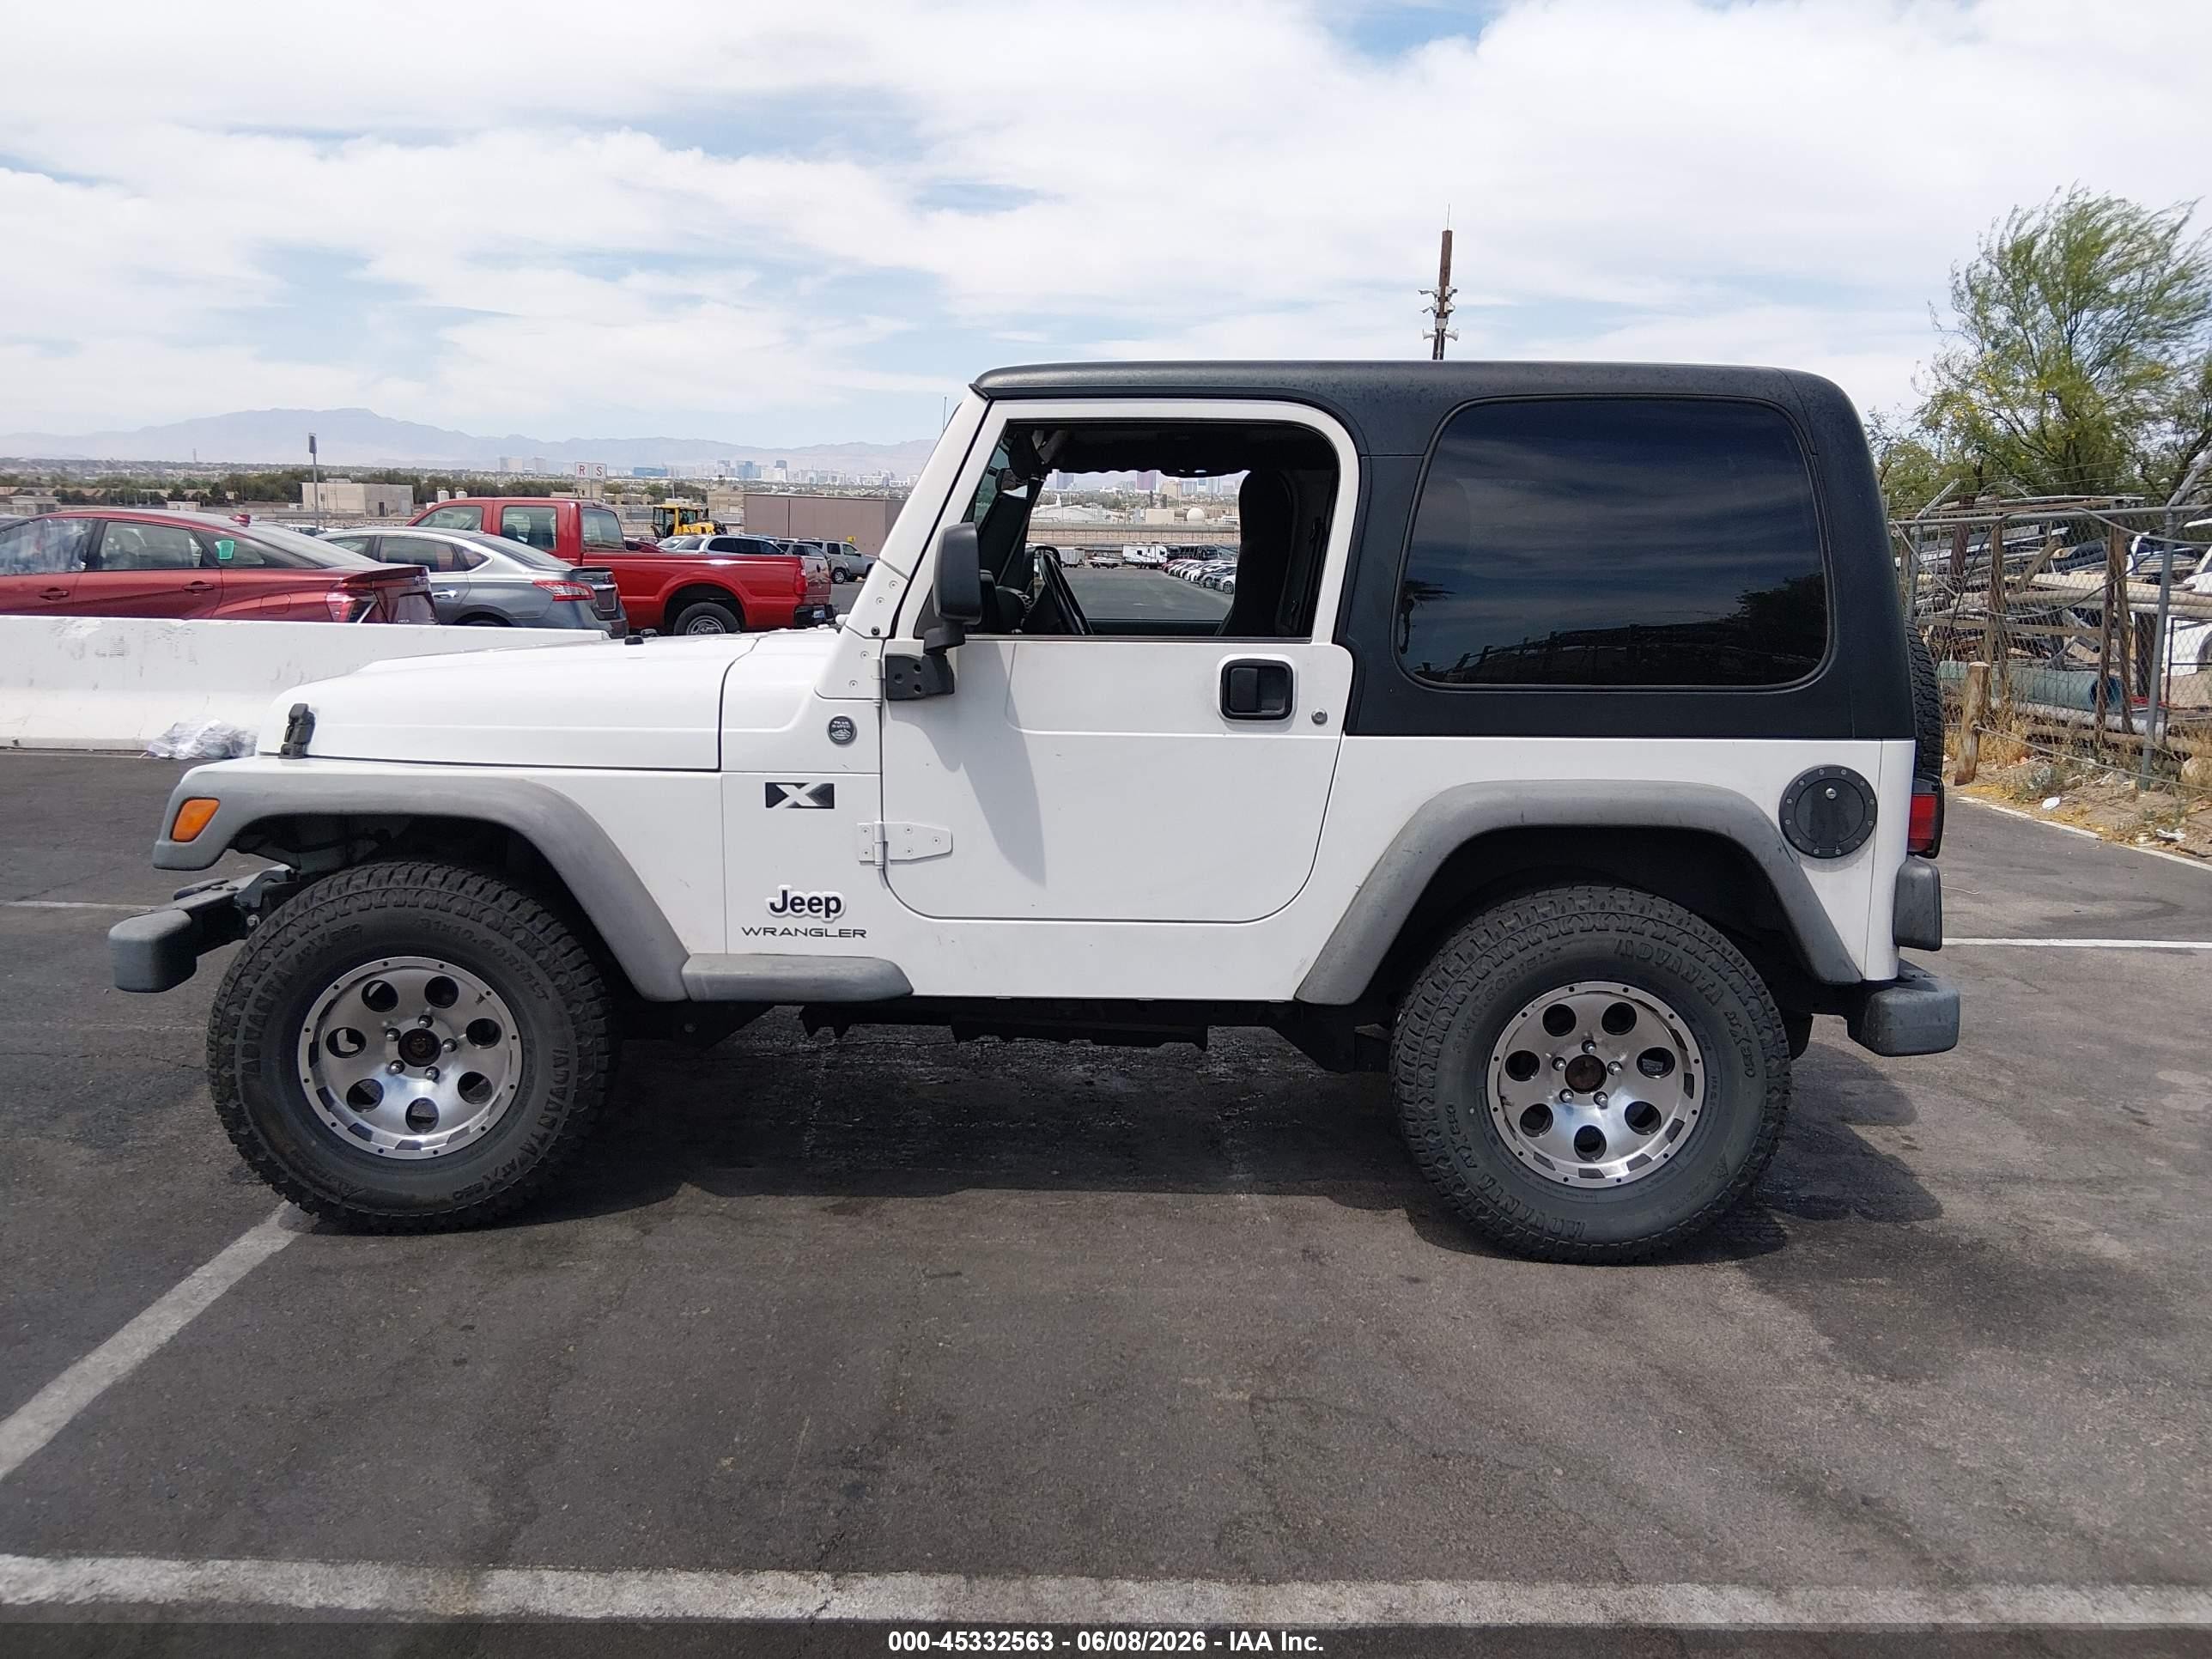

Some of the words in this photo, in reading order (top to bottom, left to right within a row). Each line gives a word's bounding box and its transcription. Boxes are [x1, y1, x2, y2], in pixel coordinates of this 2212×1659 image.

[769, 887, 843, 920] Jeep
[740, 926, 868, 939] WRANGLER
[1613, 938, 1725, 1007] ADVANTA
